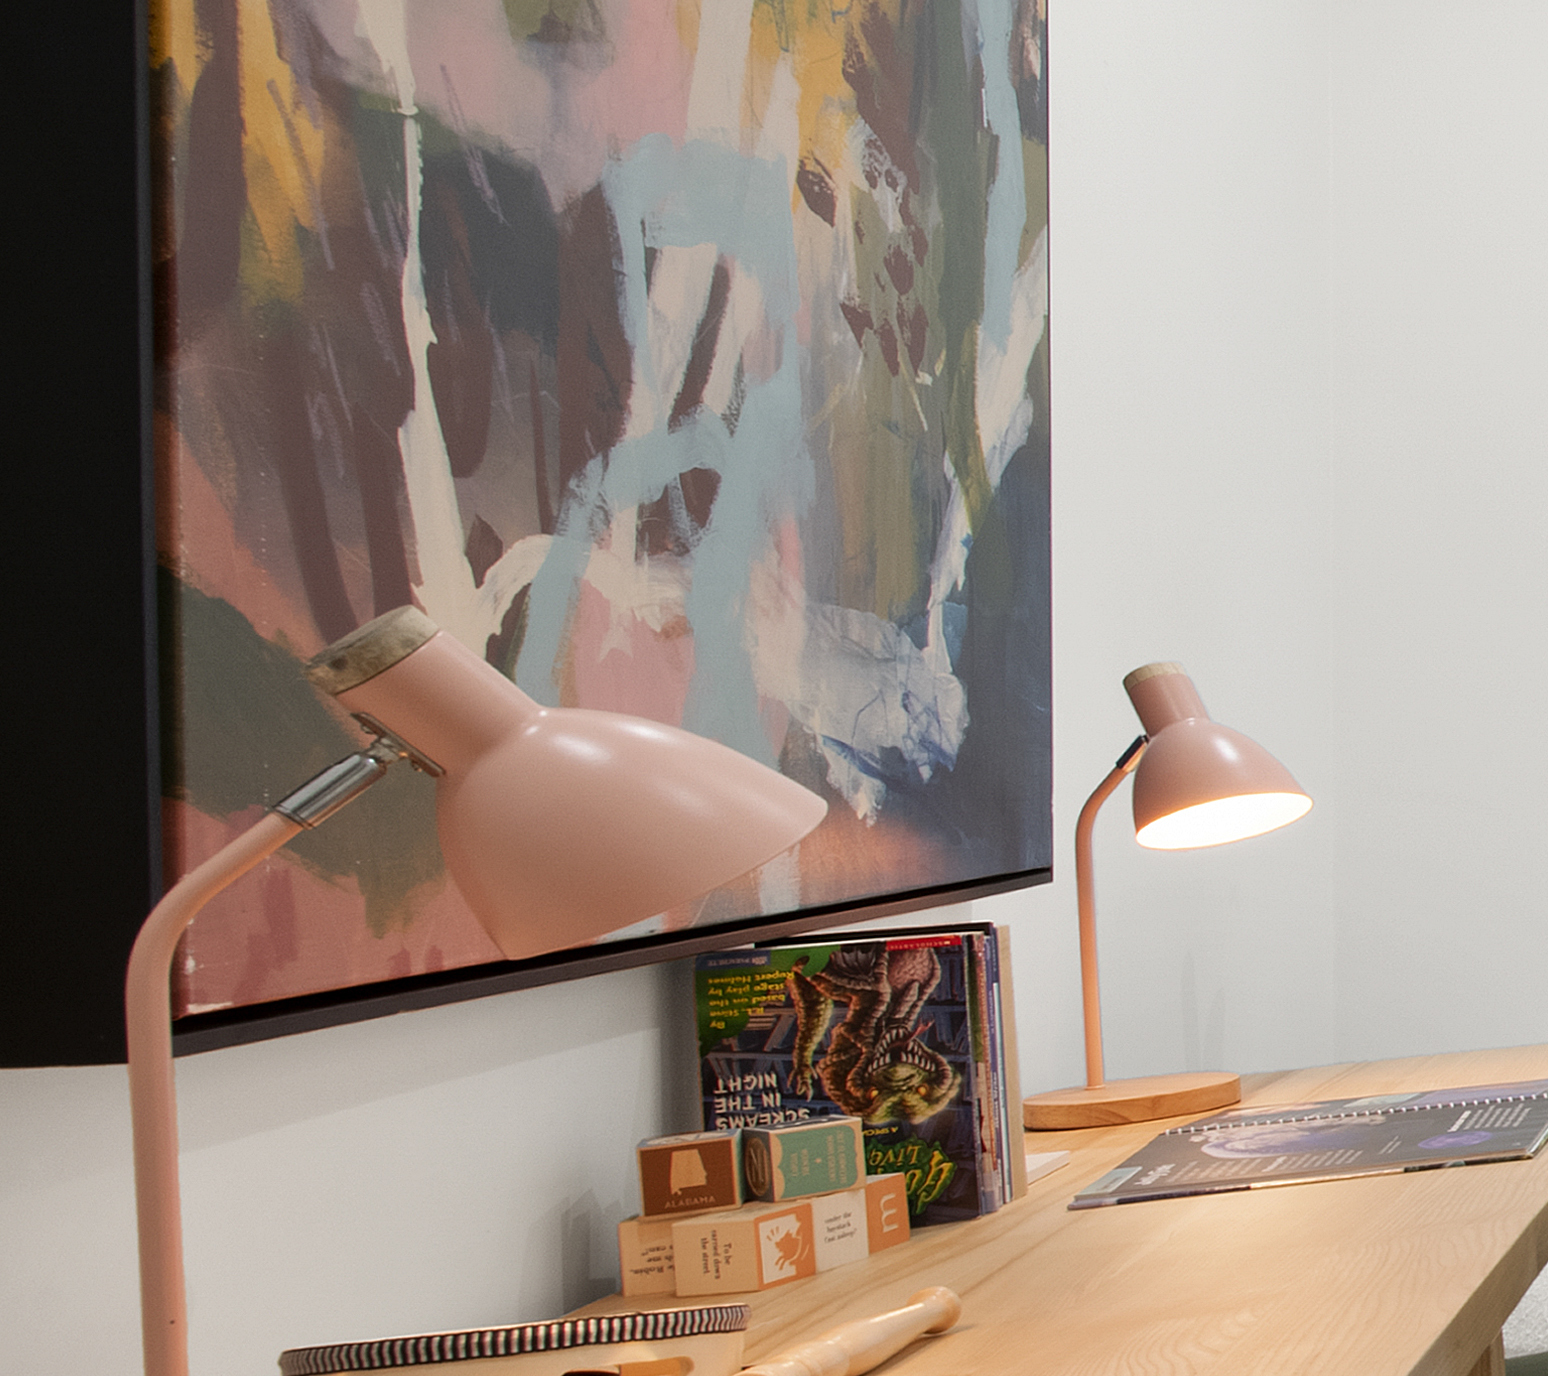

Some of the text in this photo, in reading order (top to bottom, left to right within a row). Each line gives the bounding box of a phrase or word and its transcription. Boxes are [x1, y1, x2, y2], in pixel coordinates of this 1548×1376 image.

[890, 941, 943, 949] SCHOLASTIC
[754, 971, 795, 981] Rupert
[708, 982, 784, 996] stage play by
[752, 995, 785, 1004] based
[709, 1020, 726, 1029] By
[713, 1072, 778, 1095] NIGHT
[713, 1092, 782, 1114] IN THE
[715, 1108, 811, 1131] SCREAMS
[664, 1195, 716, 1209] ALABAMA
